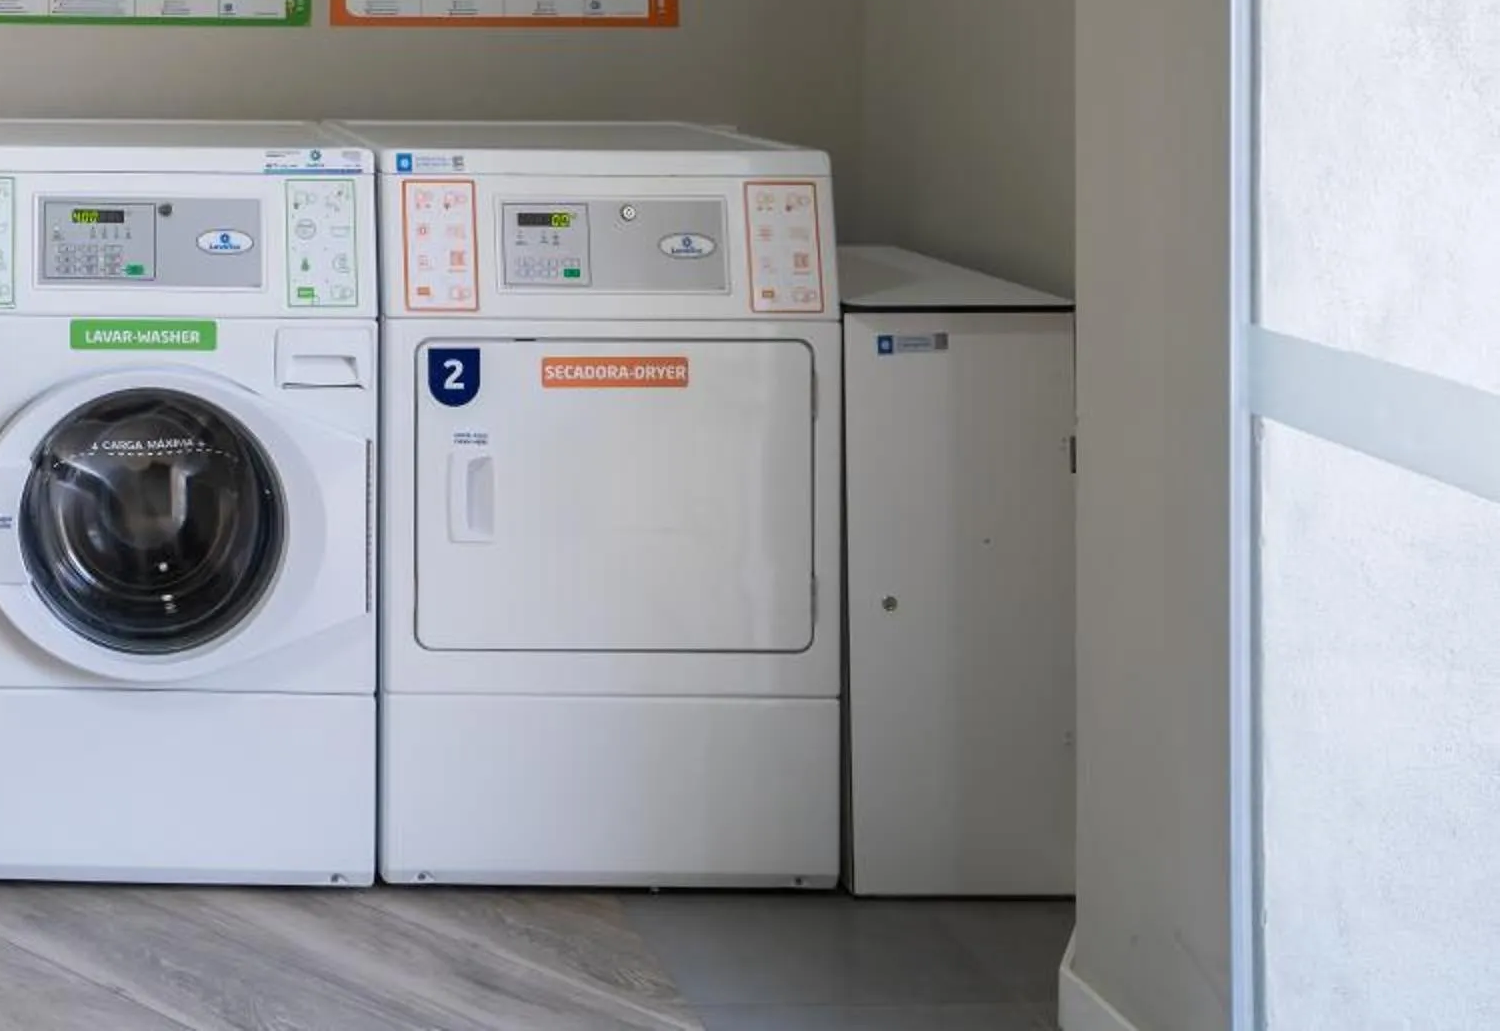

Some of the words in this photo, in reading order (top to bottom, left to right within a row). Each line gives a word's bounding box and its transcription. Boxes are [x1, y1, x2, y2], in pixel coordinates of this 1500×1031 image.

[85, 330, 200, 344] LAVAR-WASHER
[443, 358, 465, 390] 2
[545, 364, 687, 380] SECADORA-DRYER
[102, 440, 143, 451] CARGA
